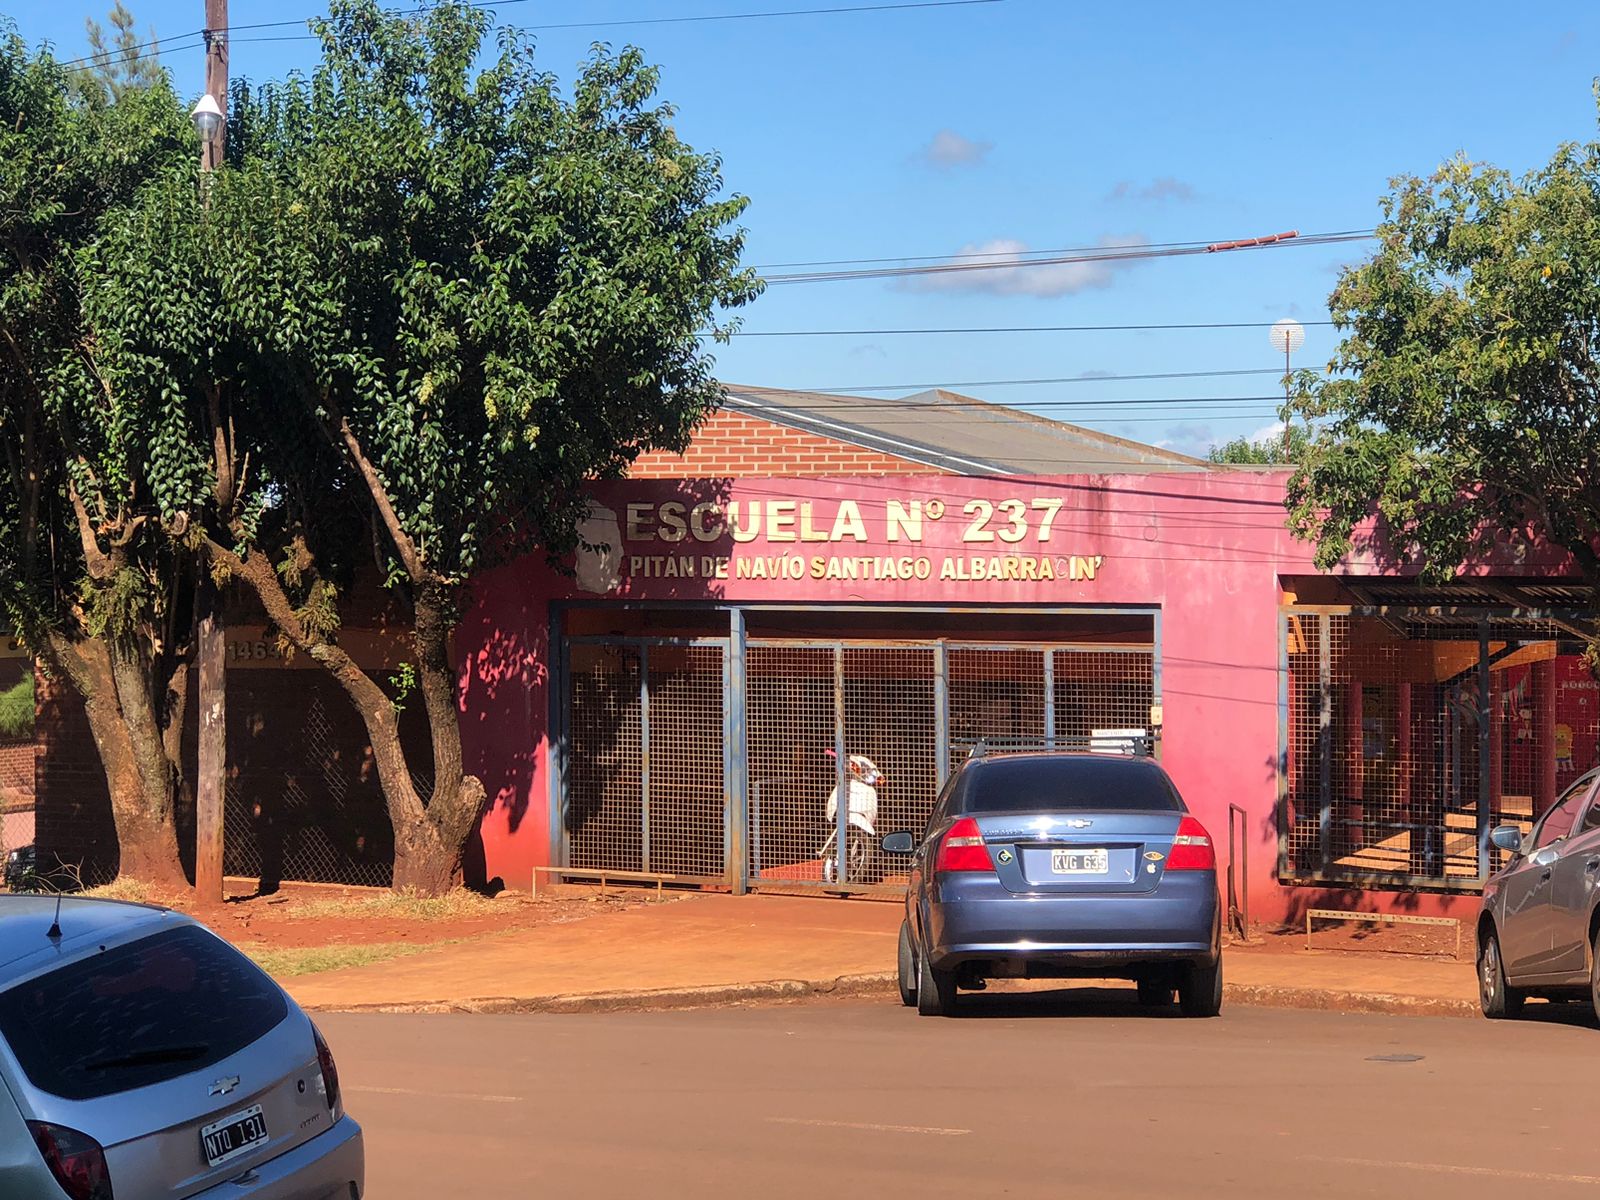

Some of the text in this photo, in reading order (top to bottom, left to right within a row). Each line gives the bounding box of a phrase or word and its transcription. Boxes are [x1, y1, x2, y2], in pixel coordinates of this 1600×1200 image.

[626, 499, 868, 542] ESCUELA
[963, 498, 1067, 542] 237
[630, 551, 695, 579] PITÁN
[702, 555, 729, 580] DE
[736, 551, 805, 580] NAVÍO
[809, 555, 931, 581] SANTIAGO
[1054, 854, 1107, 870] KVG 635
[237, 1115, 266, 1144] 131
